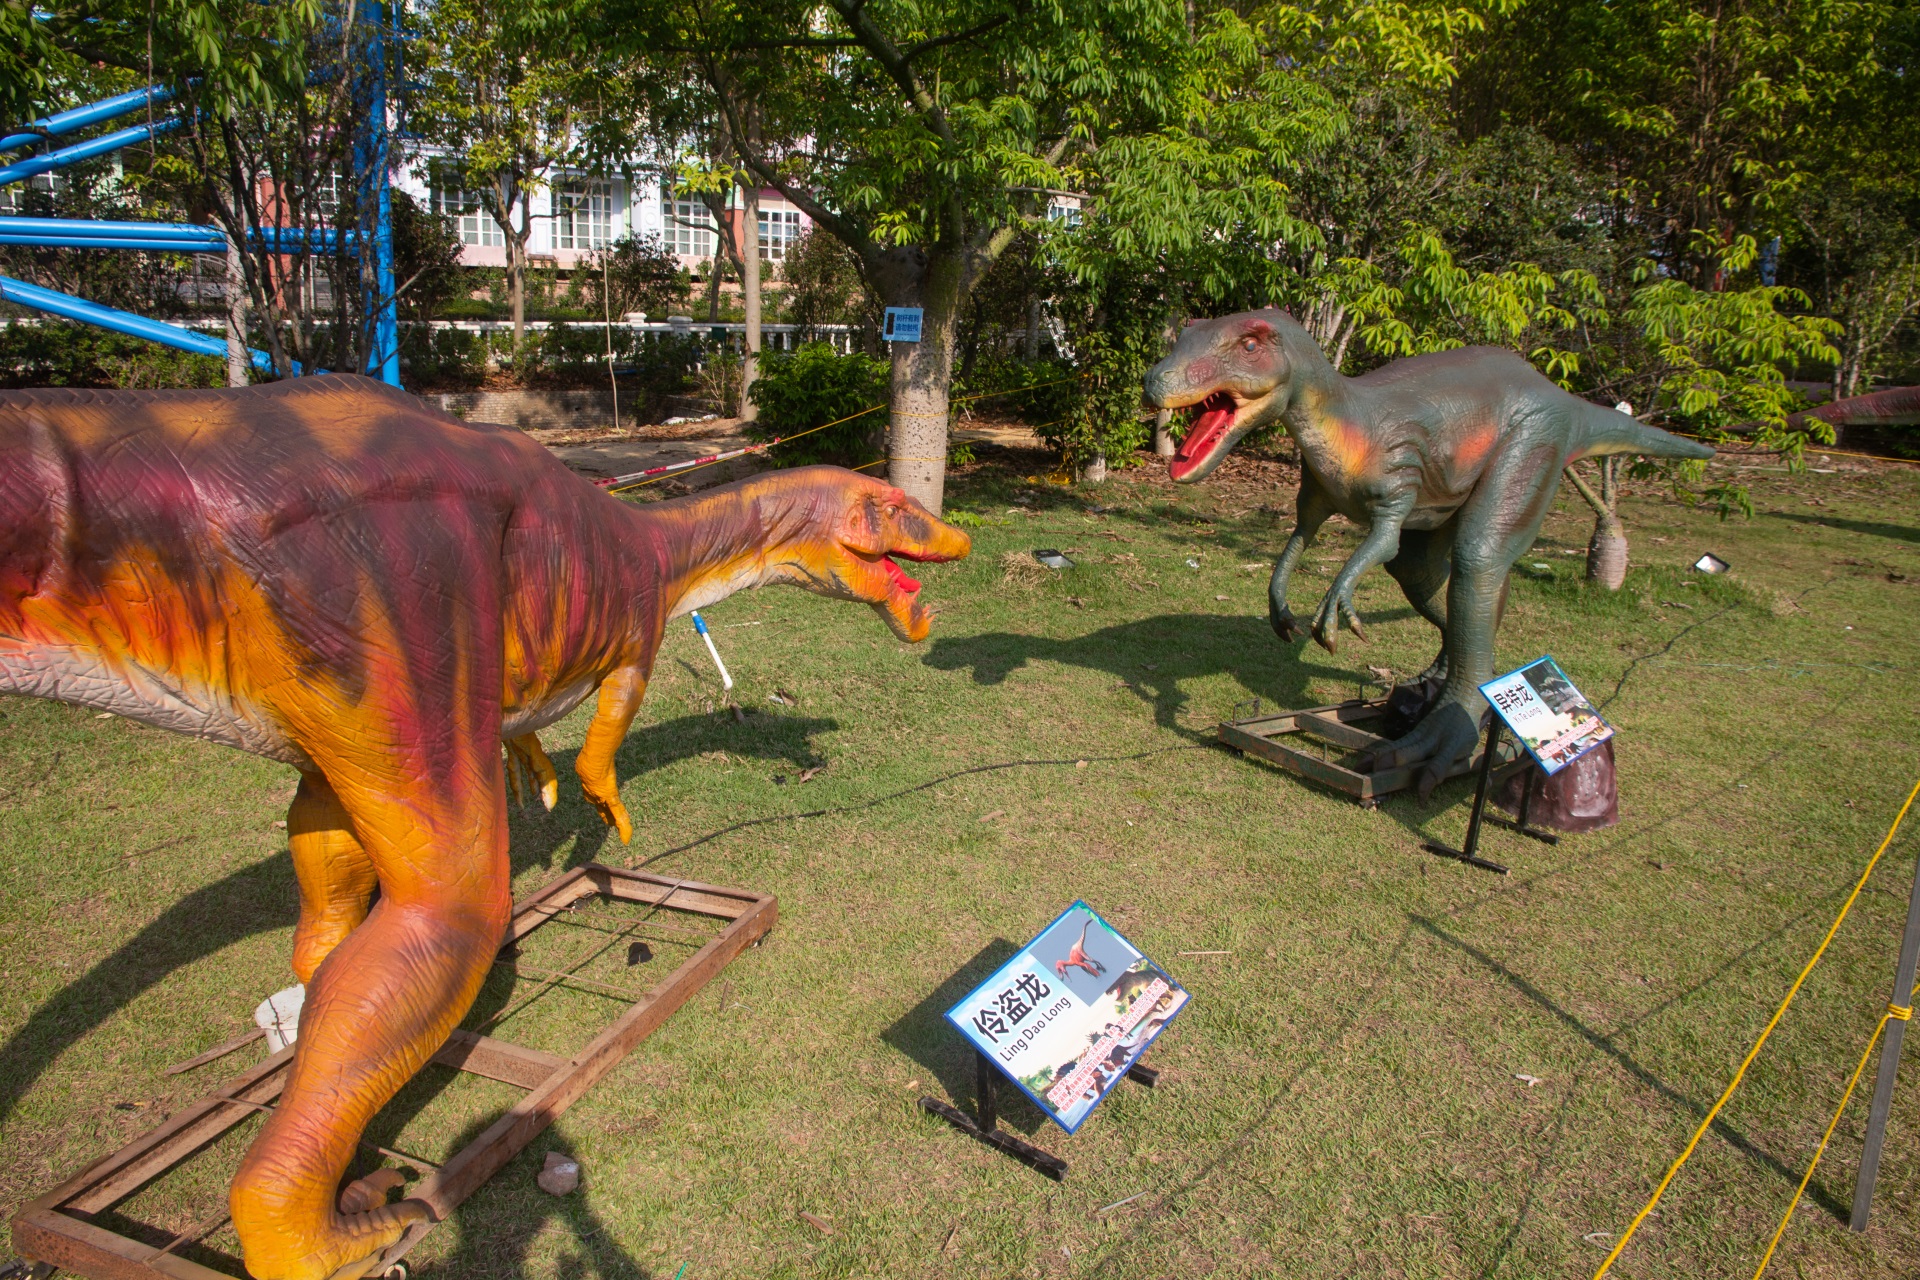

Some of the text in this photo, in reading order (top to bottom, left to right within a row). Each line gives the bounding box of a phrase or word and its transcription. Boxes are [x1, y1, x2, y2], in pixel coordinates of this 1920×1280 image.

[1493, 683, 1534, 714] 异特龙
[1513, 716, 1522, 724] Yi
[1528, 706, 1542, 719] Long
[972, 973, 1051, 1044] 伶盗龙
[999, 996, 1072, 1062] Ling Dao Long
